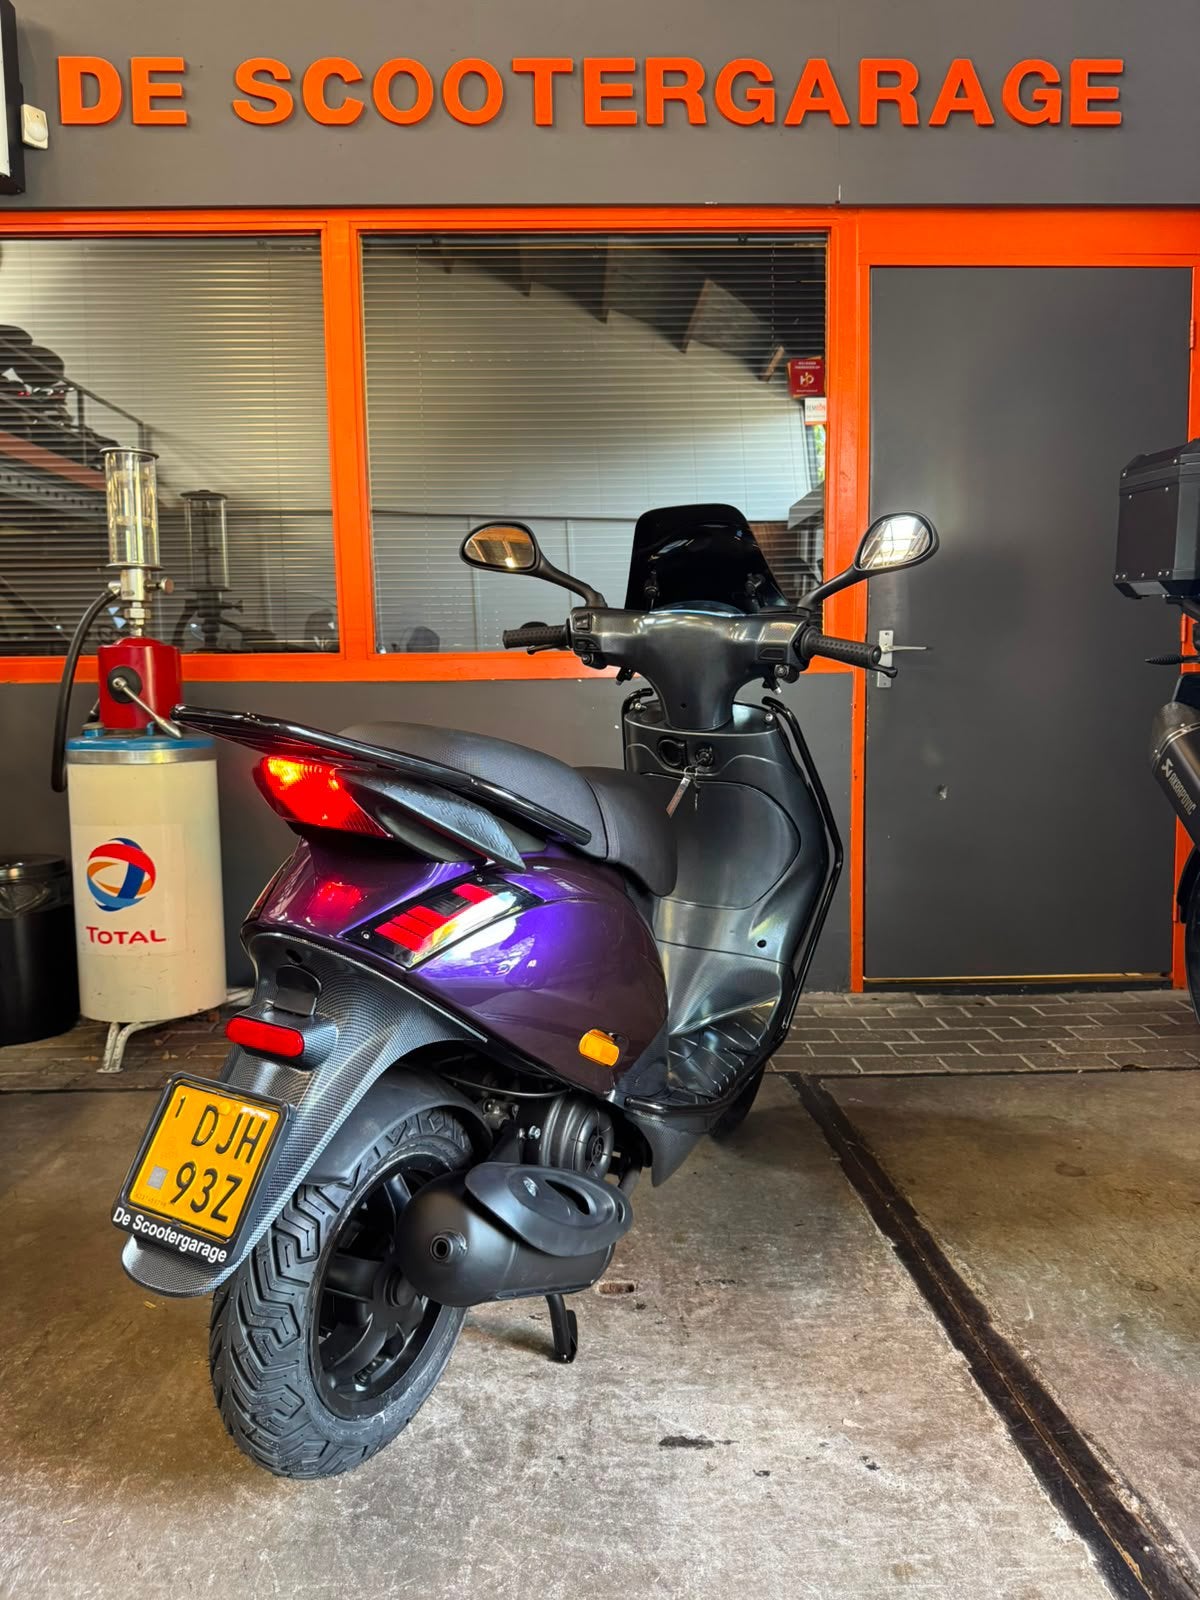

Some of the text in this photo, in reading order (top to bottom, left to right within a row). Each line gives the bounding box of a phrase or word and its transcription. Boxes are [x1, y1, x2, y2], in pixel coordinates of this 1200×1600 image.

[58, 55, 1124, 127] DE SCOOTERGARAGE
[85, 925, 167, 945] TOTAL
[175, 1096, 268, 1164] 1 DJH
[170, 1161, 243, 1223] 93Z
[112, 1206, 228, 1263] De Scootergarage
